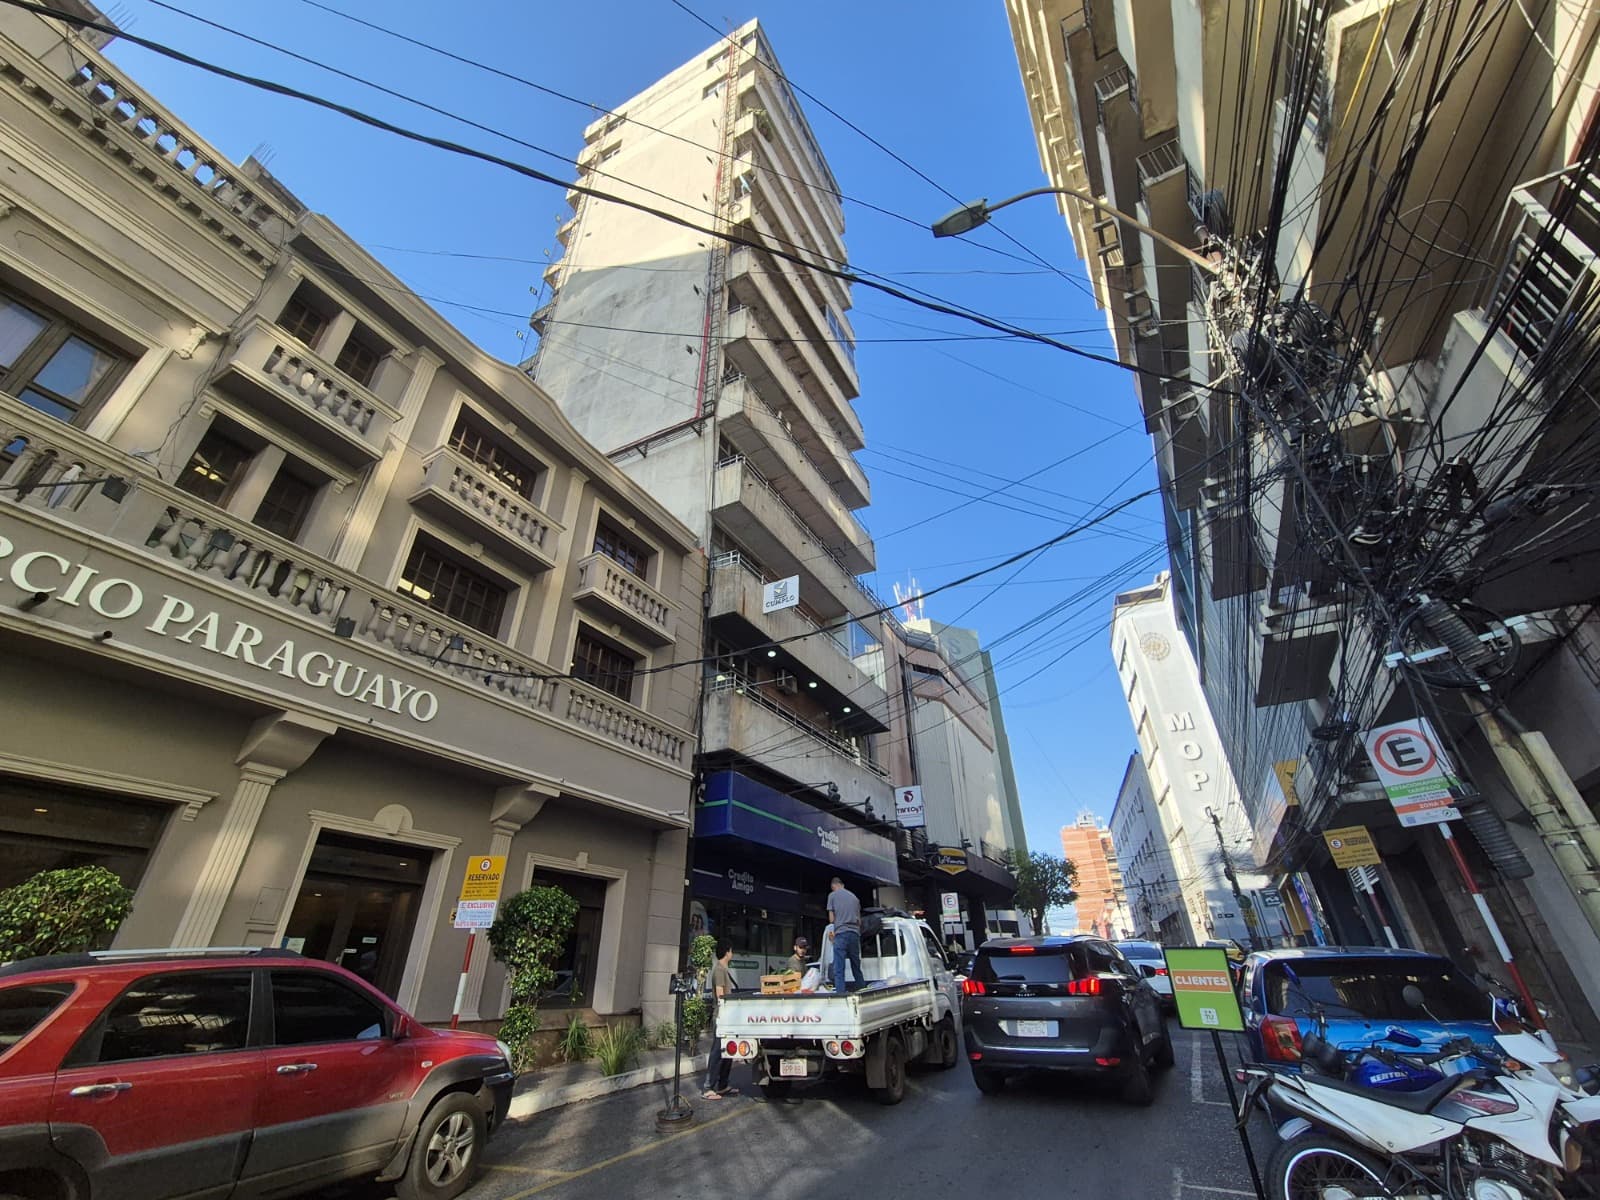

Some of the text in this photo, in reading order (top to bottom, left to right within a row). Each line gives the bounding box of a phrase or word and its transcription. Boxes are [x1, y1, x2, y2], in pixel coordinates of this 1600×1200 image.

[145, 594, 439, 722] PARAGUAYO
[1386, 737, 1424, 768] E
[1174, 975, 1228, 986] CLIENTES
[770, 1014, 822, 1024] MOTORS
